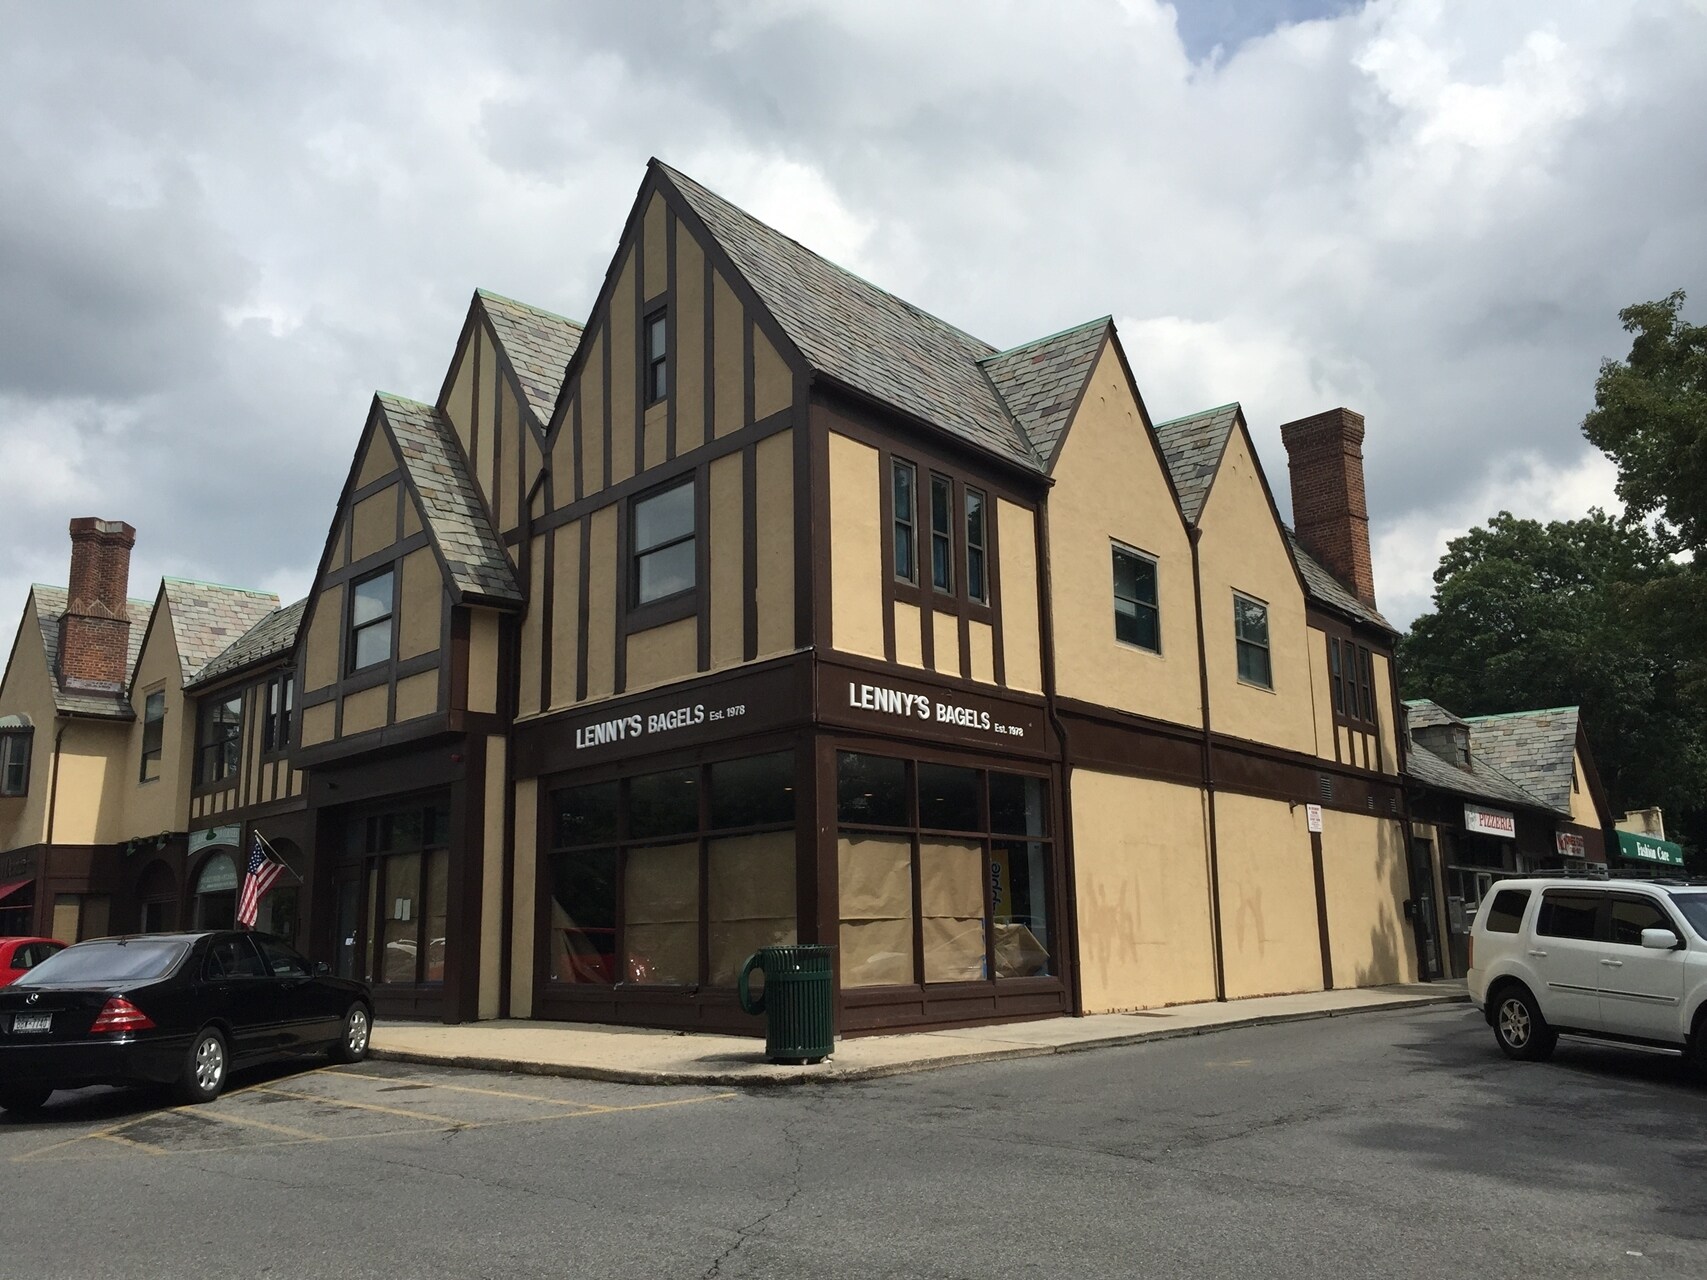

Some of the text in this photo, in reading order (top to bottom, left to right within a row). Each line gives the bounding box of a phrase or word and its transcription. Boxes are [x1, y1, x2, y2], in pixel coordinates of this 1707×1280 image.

[849, 683, 930, 720] LENNY'S
[936, 703, 991, 730] BAGELS
[994, 723, 1007, 734] Est.
[576, 704, 746, 749] LENNY'S BAGELS Est. 1978
[1479, 812, 1513, 831] PIZZERIA
[1636, 841, 1657, 859] Fashion
[1656, 846, 1670, 861] Care
